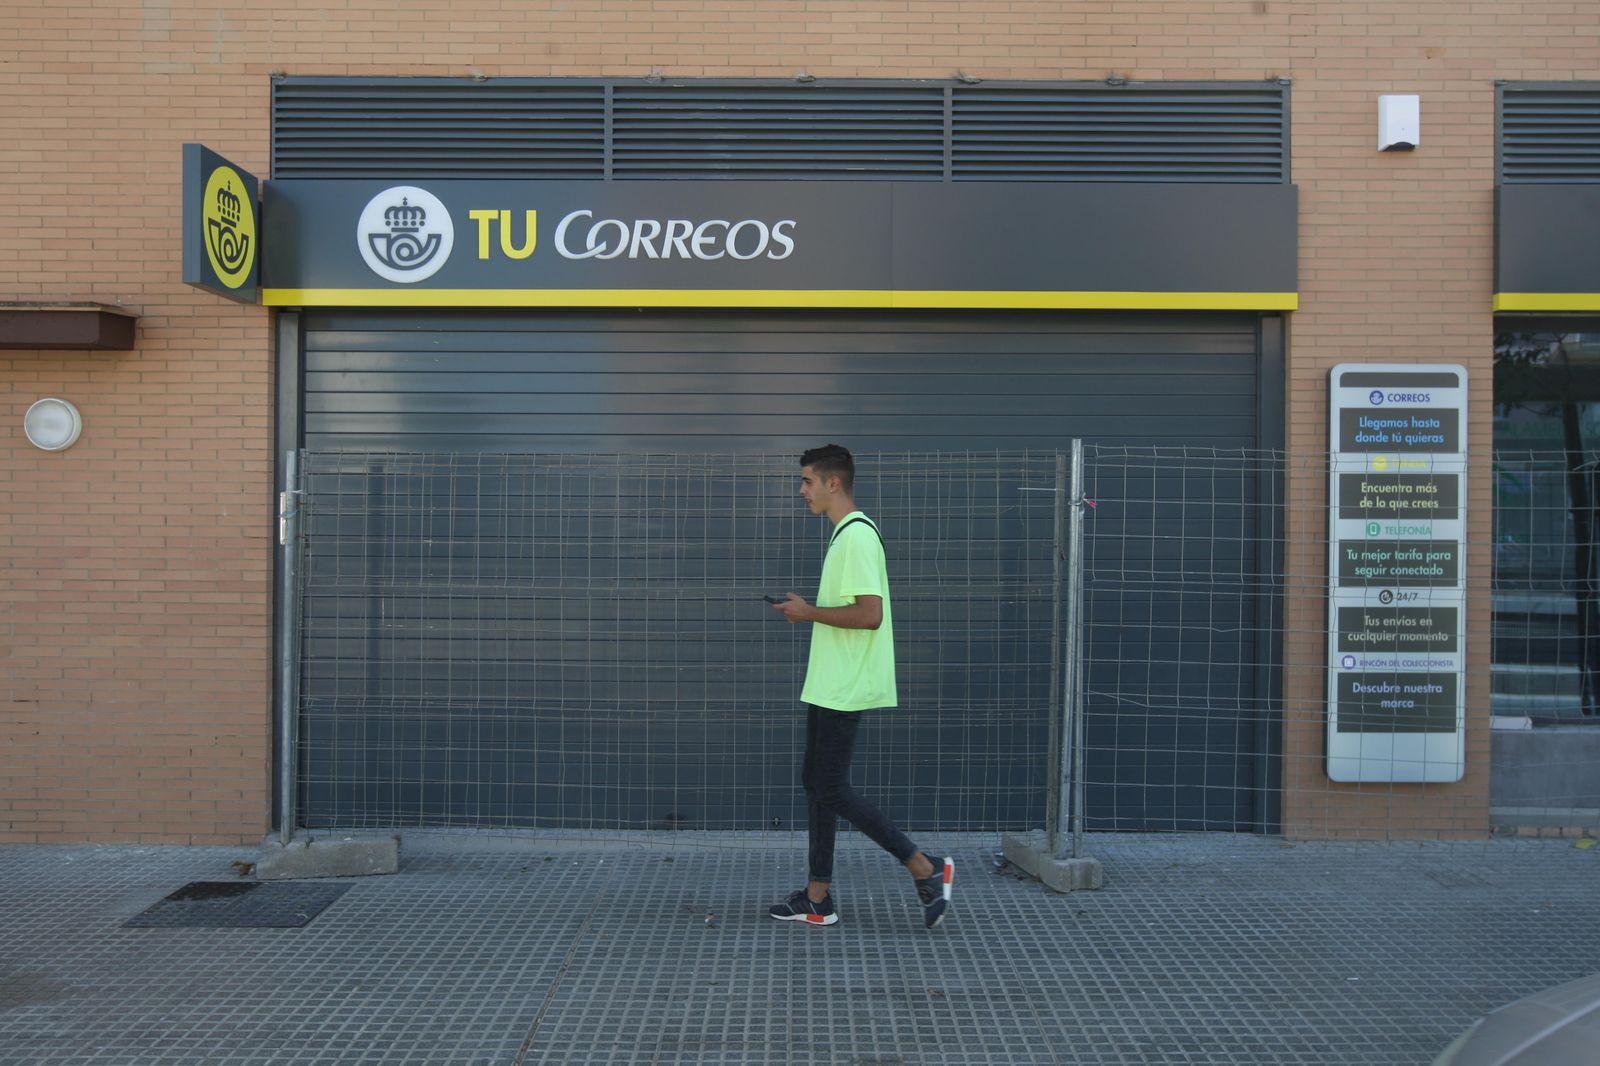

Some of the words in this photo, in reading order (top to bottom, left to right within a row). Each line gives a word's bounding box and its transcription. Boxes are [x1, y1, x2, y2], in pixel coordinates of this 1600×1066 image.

[469, 209, 537, 260] TU
[554, 209, 797, 261] CORREOS
[1387, 393, 1430, 403] CORREOS
[1359, 416, 1408, 430] Llegamos
[1411, 416, 1440, 428] hasta
[1355, 431, 1389, 443] donde
[1392, 431, 1402, 443] tú
[1405, 431, 1444, 445] quieras
[1361, 482, 1412, 494] Encuentra
[1416, 482, 1438, 494] más
[1359, 496, 1374, 508] de
[1376, 496, 1386, 508] lo
[1389, 499, 1408, 511] que
[1412, 499, 1439, 508] crees
[1384, 524, 1432, 535] TELEFONÍA
[1347, 549, 1358, 560] Tu
[1361, 550, 1391, 564] mejor
[1395, 548, 1423, 560] tarifa
[1426, 551, 1451, 564] para
[1354, 563, 1388, 577] seguir
[1391, 563, 1443, 575] conectado
[1396, 592, 1418, 602] 24/7
[1364, 615, 1380, 626] Tus
[1420, 618, 1433, 626] en
[1347, 630, 1397, 644] cualquier
[1399, 631, 1448, 641] momento
[1389, 659, 1400, 667] DEL
[1352, 682, 1401, 693] Descubre
[1404, 682, 1443, 693] nuestra
[1380, 699, 1415, 709] marca
